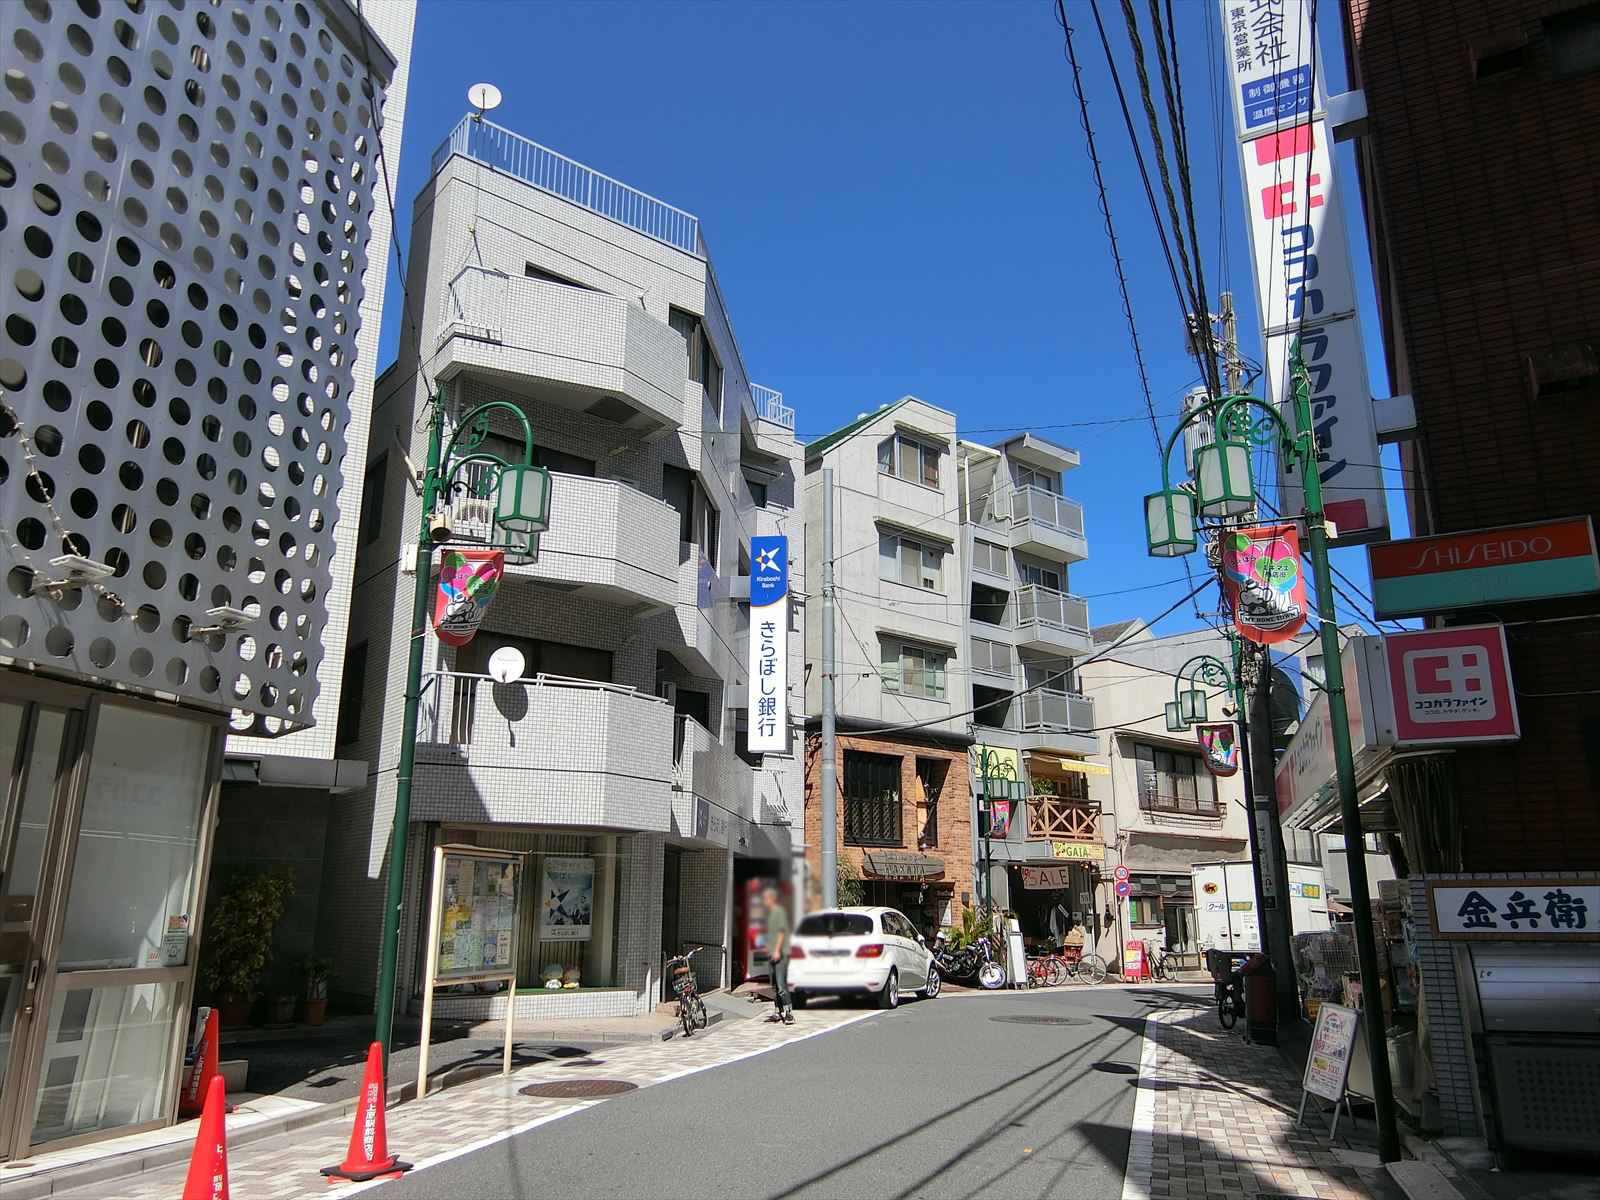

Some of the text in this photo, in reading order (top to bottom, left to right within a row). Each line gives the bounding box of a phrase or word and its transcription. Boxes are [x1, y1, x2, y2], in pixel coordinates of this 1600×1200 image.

[1230, 5, 1253, 74] 東京営業所
[1248, 73, 1306, 99] 制御機器
[1407, 535, 1553, 570] SHISEIDO
[1256, 615, 1276, 624] HOME
[1276, 612, 1296, 623] TOWN
[758, 620, 778, 738] きらぼし銀行
[1414, 697, 1488, 711] ココカラファイン
[1066, 846, 1089, 858] GAIA
[1117, 869, 1126, 878] 30
[1208, 902, 1226, 911] クール
[1457, 888, 1588, 930] 金兵衛
